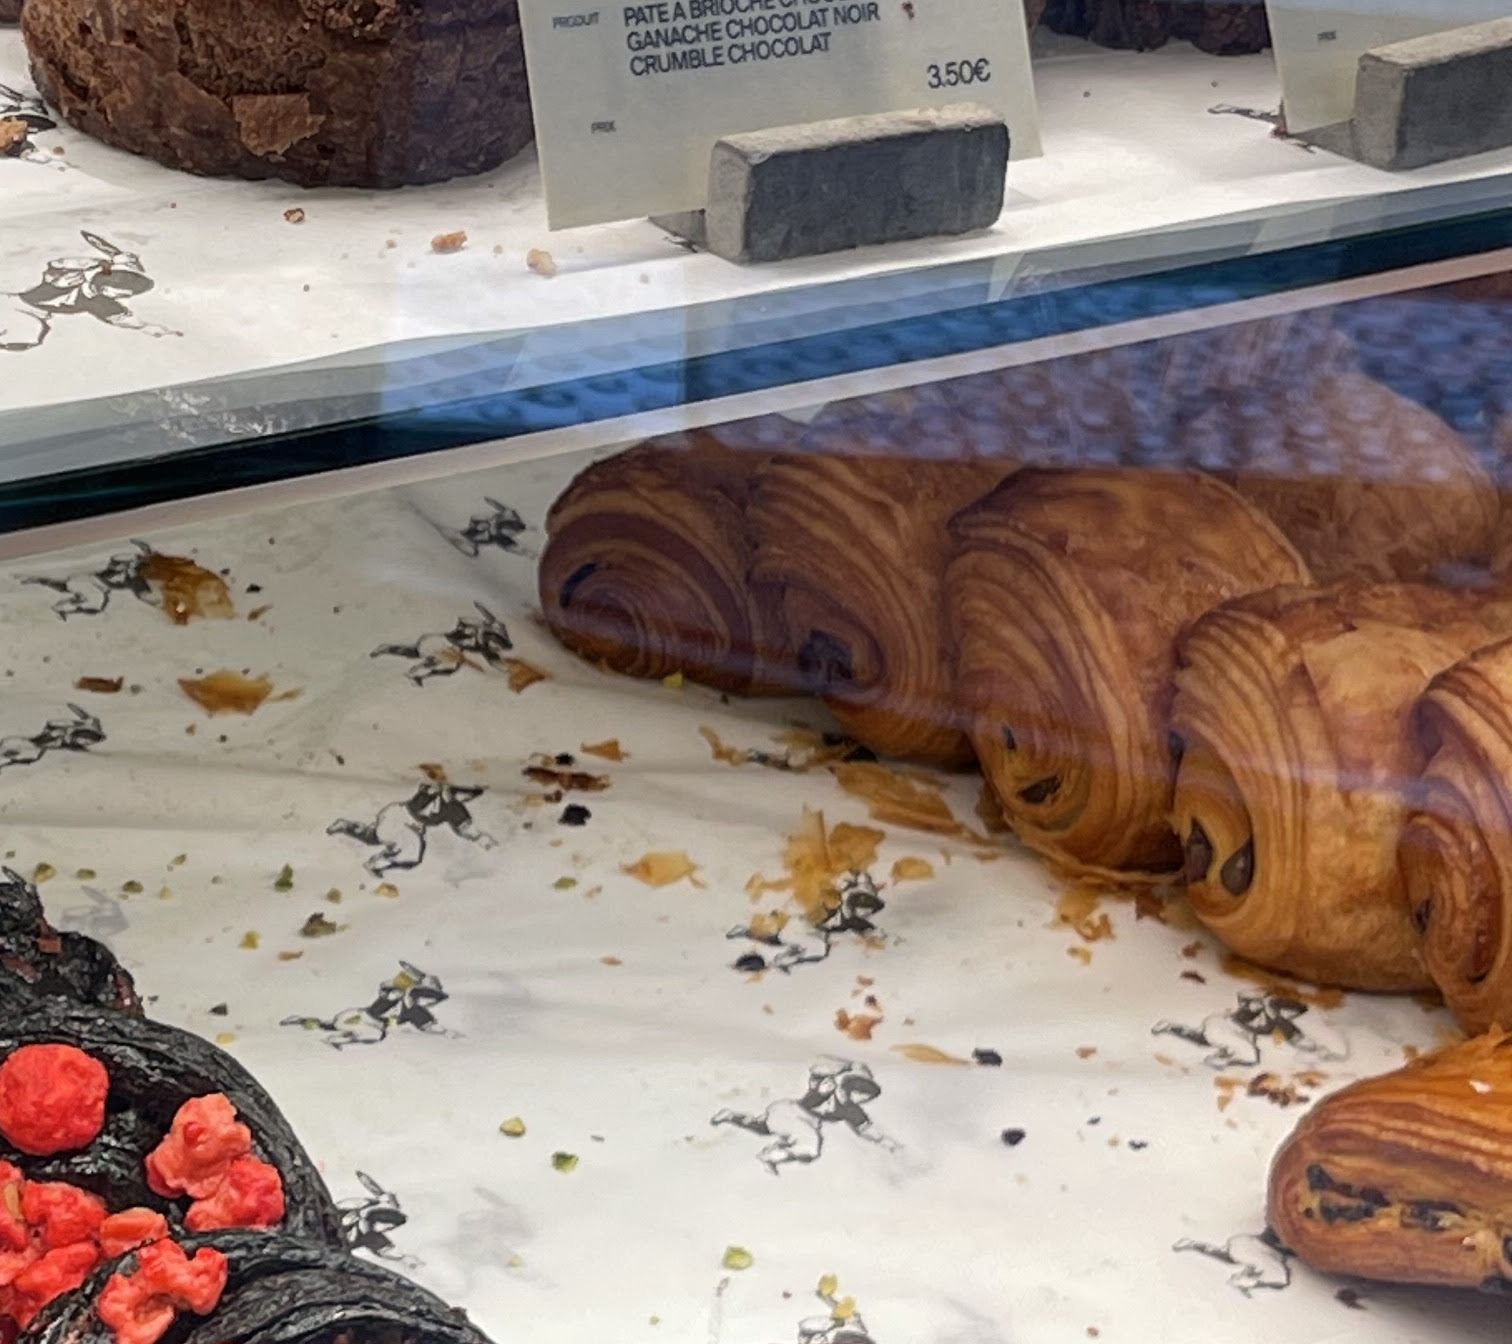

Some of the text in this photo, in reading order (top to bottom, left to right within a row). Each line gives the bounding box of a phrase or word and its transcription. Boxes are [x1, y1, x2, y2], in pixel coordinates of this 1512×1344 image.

[624, 4, 670, 27] PATE
[672, 2, 687, 21] A
[626, 2, 880, 51] GANACHE CHOCOLAT NOIR
[630, 32, 831, 76] CRUMBLE CHOCOLAT
[927, 57, 991, 89] 3.50€
